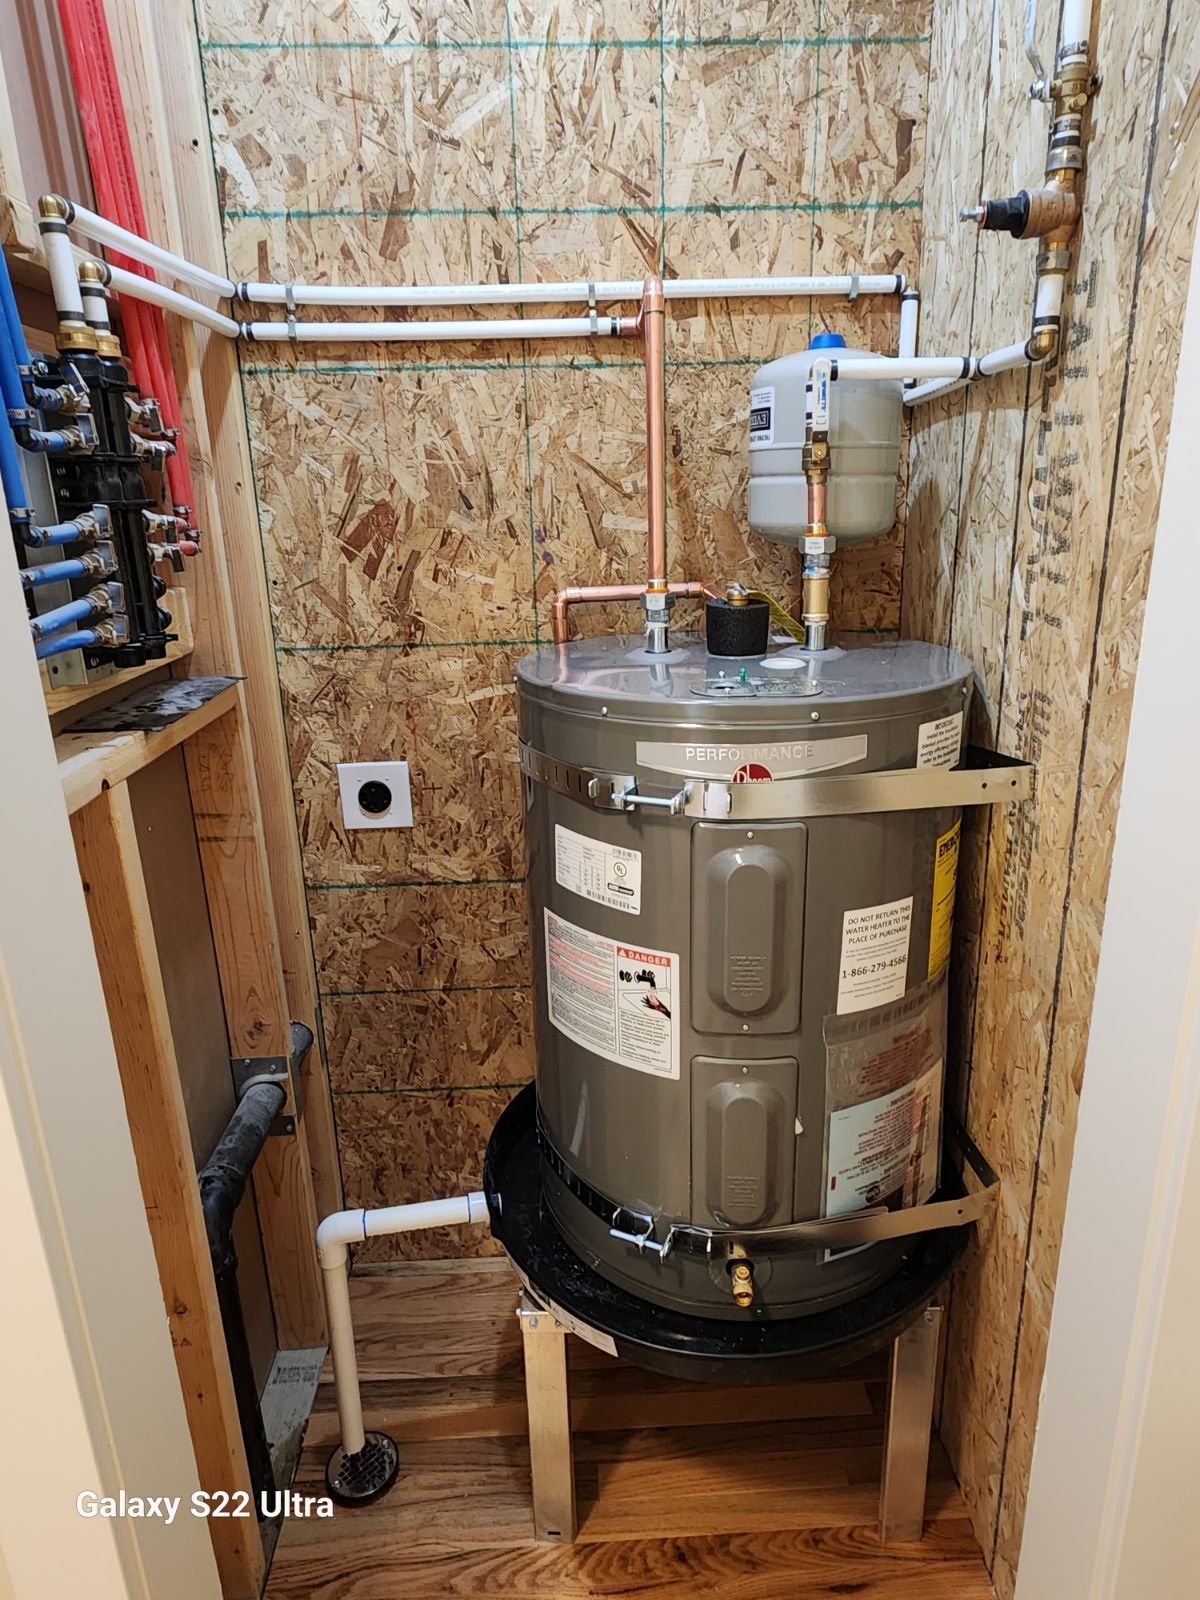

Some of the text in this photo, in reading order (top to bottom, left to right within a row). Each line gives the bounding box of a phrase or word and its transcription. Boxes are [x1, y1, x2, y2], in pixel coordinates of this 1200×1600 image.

[685, 744, 815, 761] PERFORMANCE
[846, 914, 910, 935] WATER HEATER TO THE
[848, 904, 911, 925] DO NOT RETURN THIS
[848, 936, 868, 944] PLACE
[879, 925, 907, 938] PURCHASE
[628, 952, 668, 967] DANGER
[842, 954, 907, 979] 1-866-279-4566
